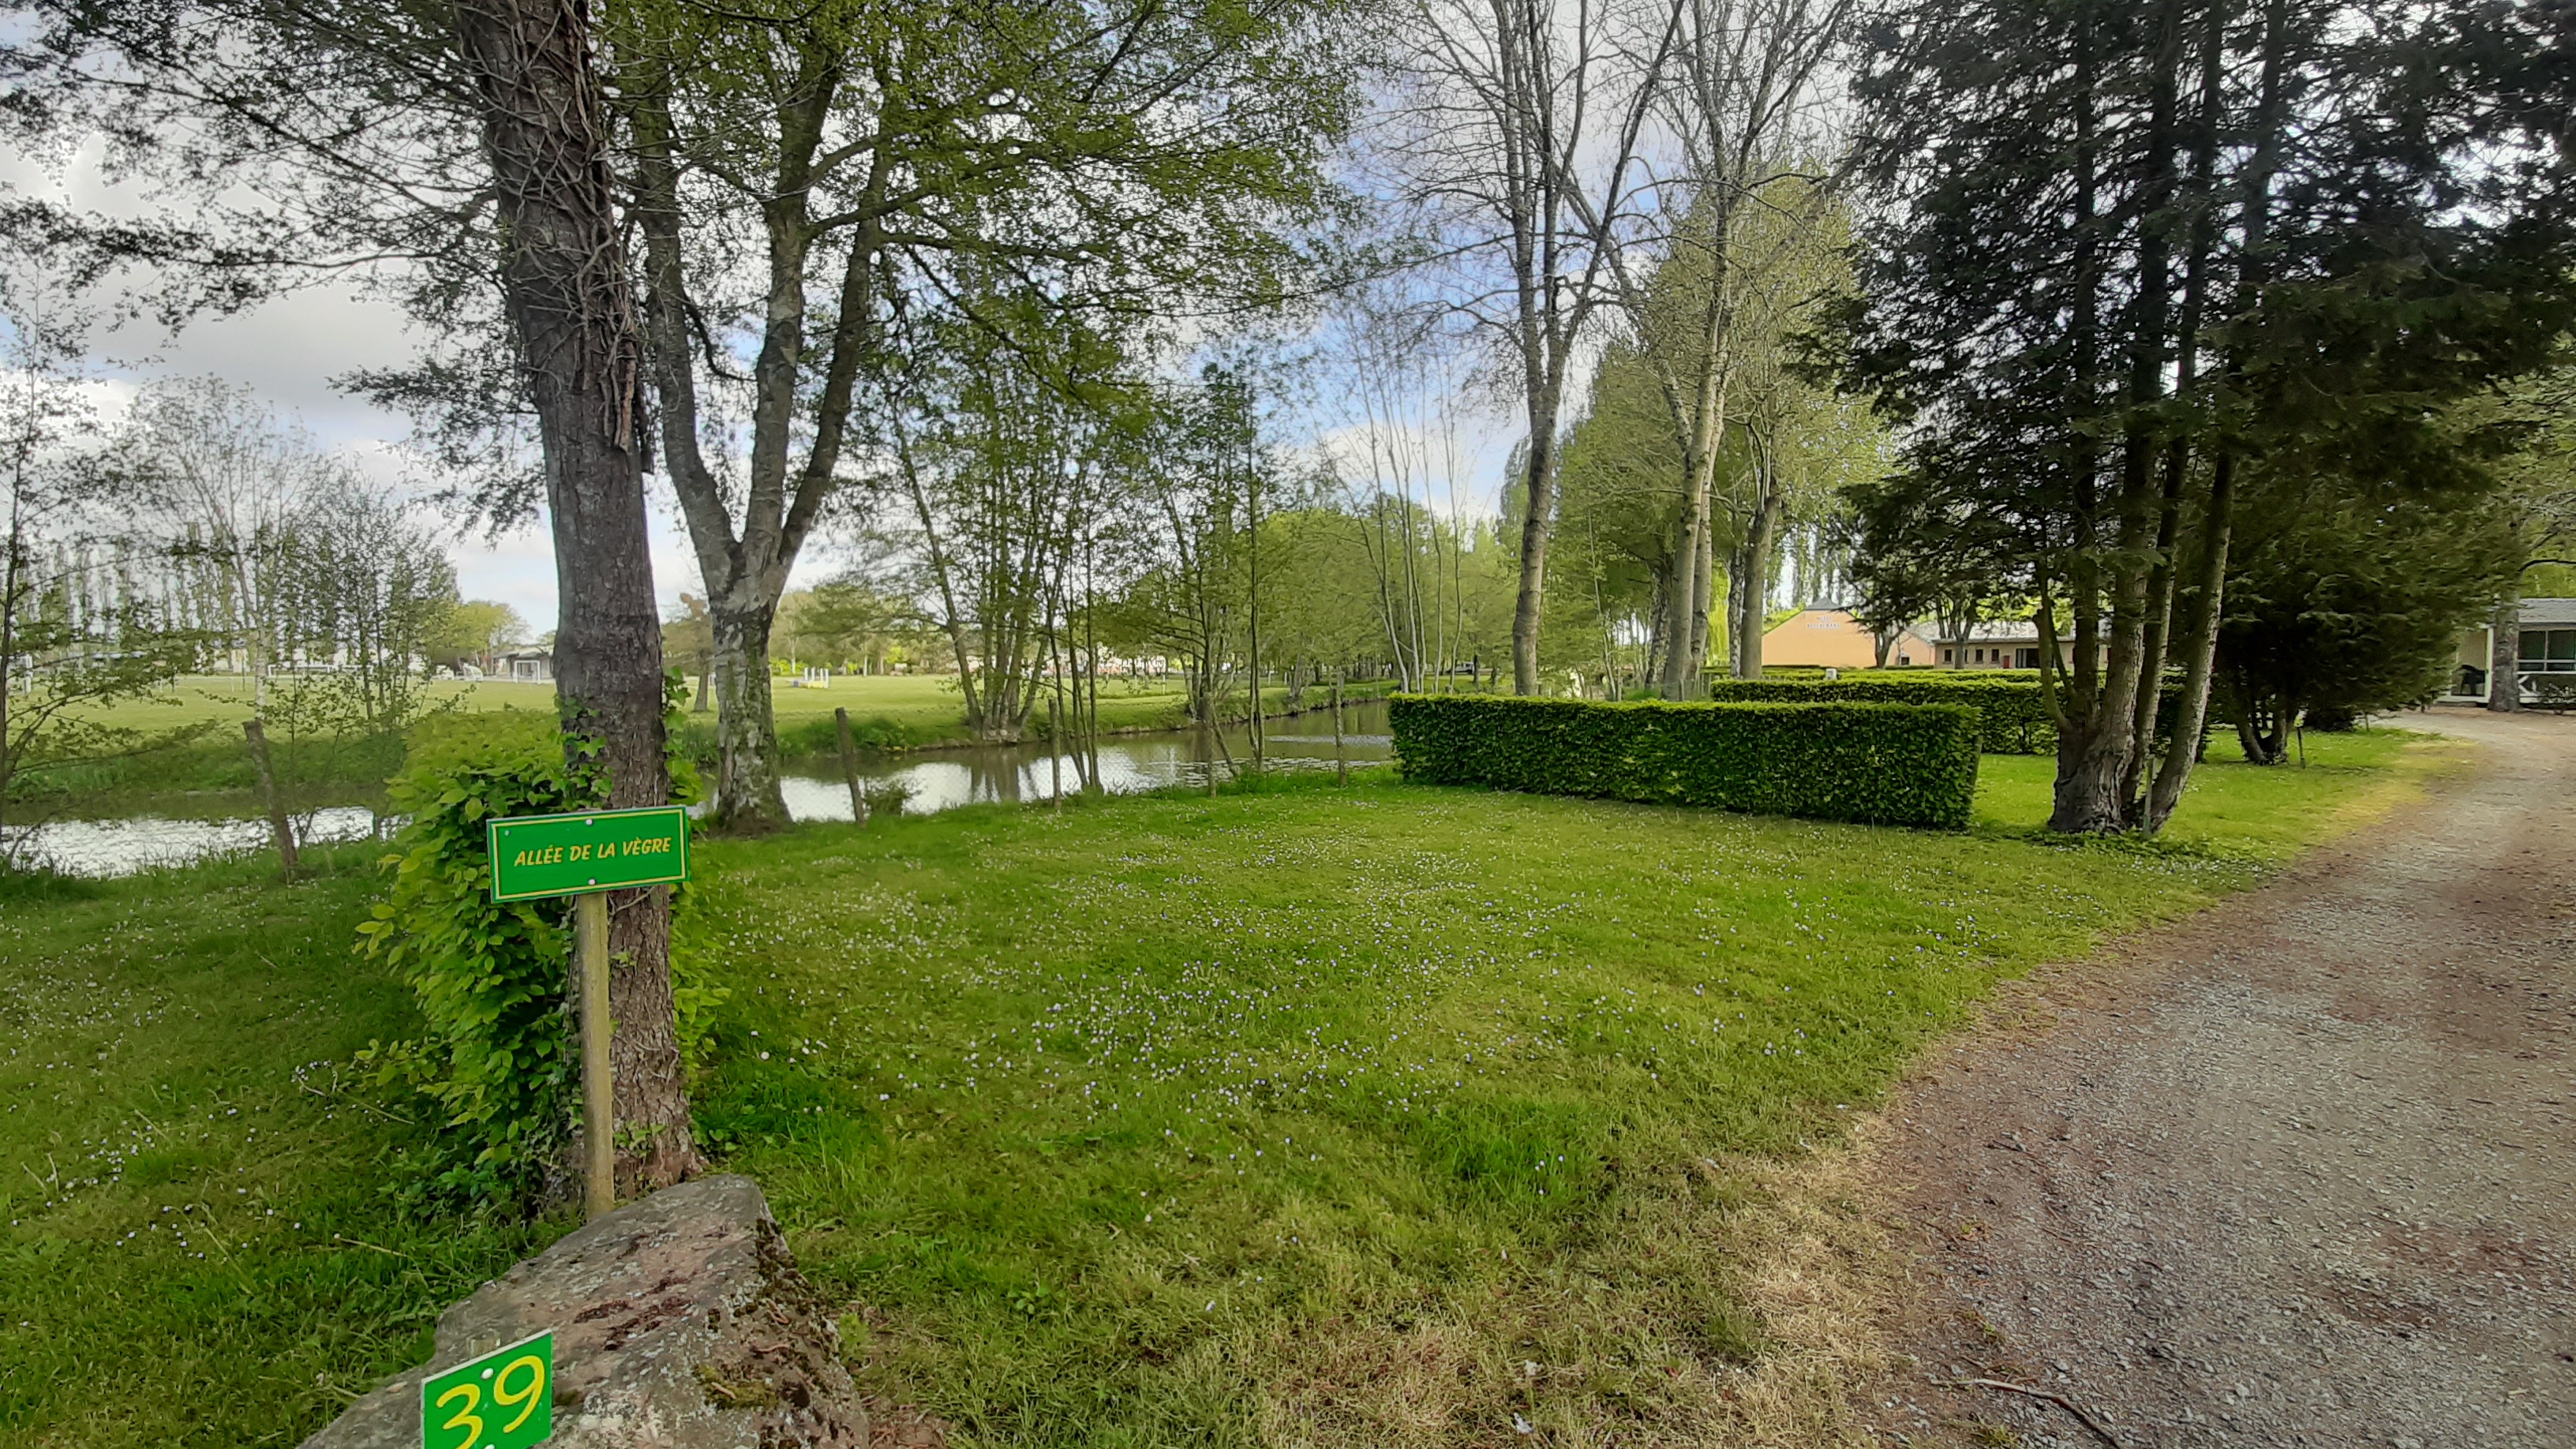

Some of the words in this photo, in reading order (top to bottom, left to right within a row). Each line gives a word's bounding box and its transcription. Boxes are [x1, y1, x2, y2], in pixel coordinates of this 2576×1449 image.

[514, 844, 563, 867] ALLÉE
[570, 844, 591, 861] DE
[597, 843, 616, 859] LA
[623, 837, 671, 856] VÈGRE
[436, 1355, 545, 1449] 39
